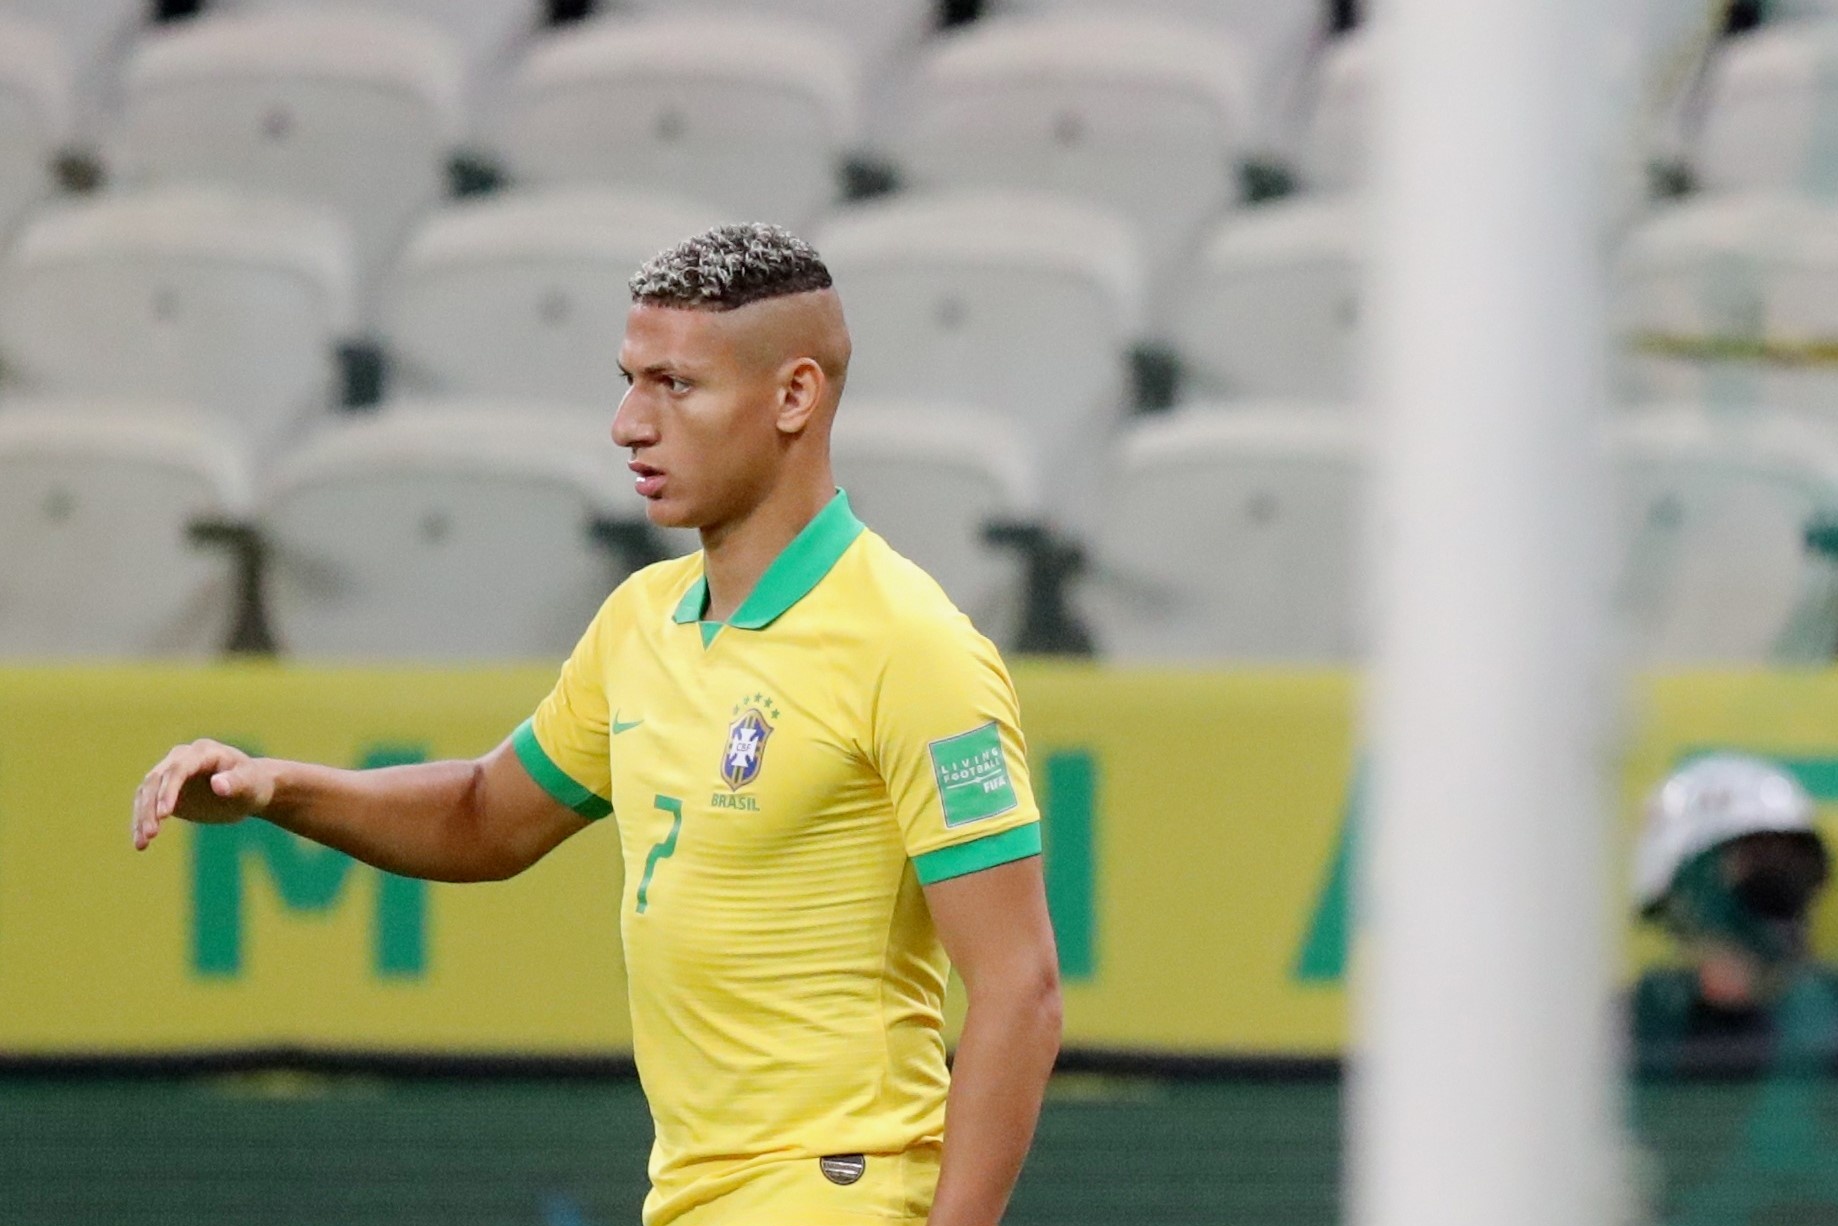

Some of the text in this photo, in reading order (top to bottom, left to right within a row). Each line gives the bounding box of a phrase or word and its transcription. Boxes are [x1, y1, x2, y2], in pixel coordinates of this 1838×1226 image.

[941, 747, 999, 775] LIVING
[943, 757, 1001, 783] FOOTBALL
[982, 775, 1007, 794] FIFA
[710, 792, 761, 812] BRASIL
[635, 793, 683, 914] 7
